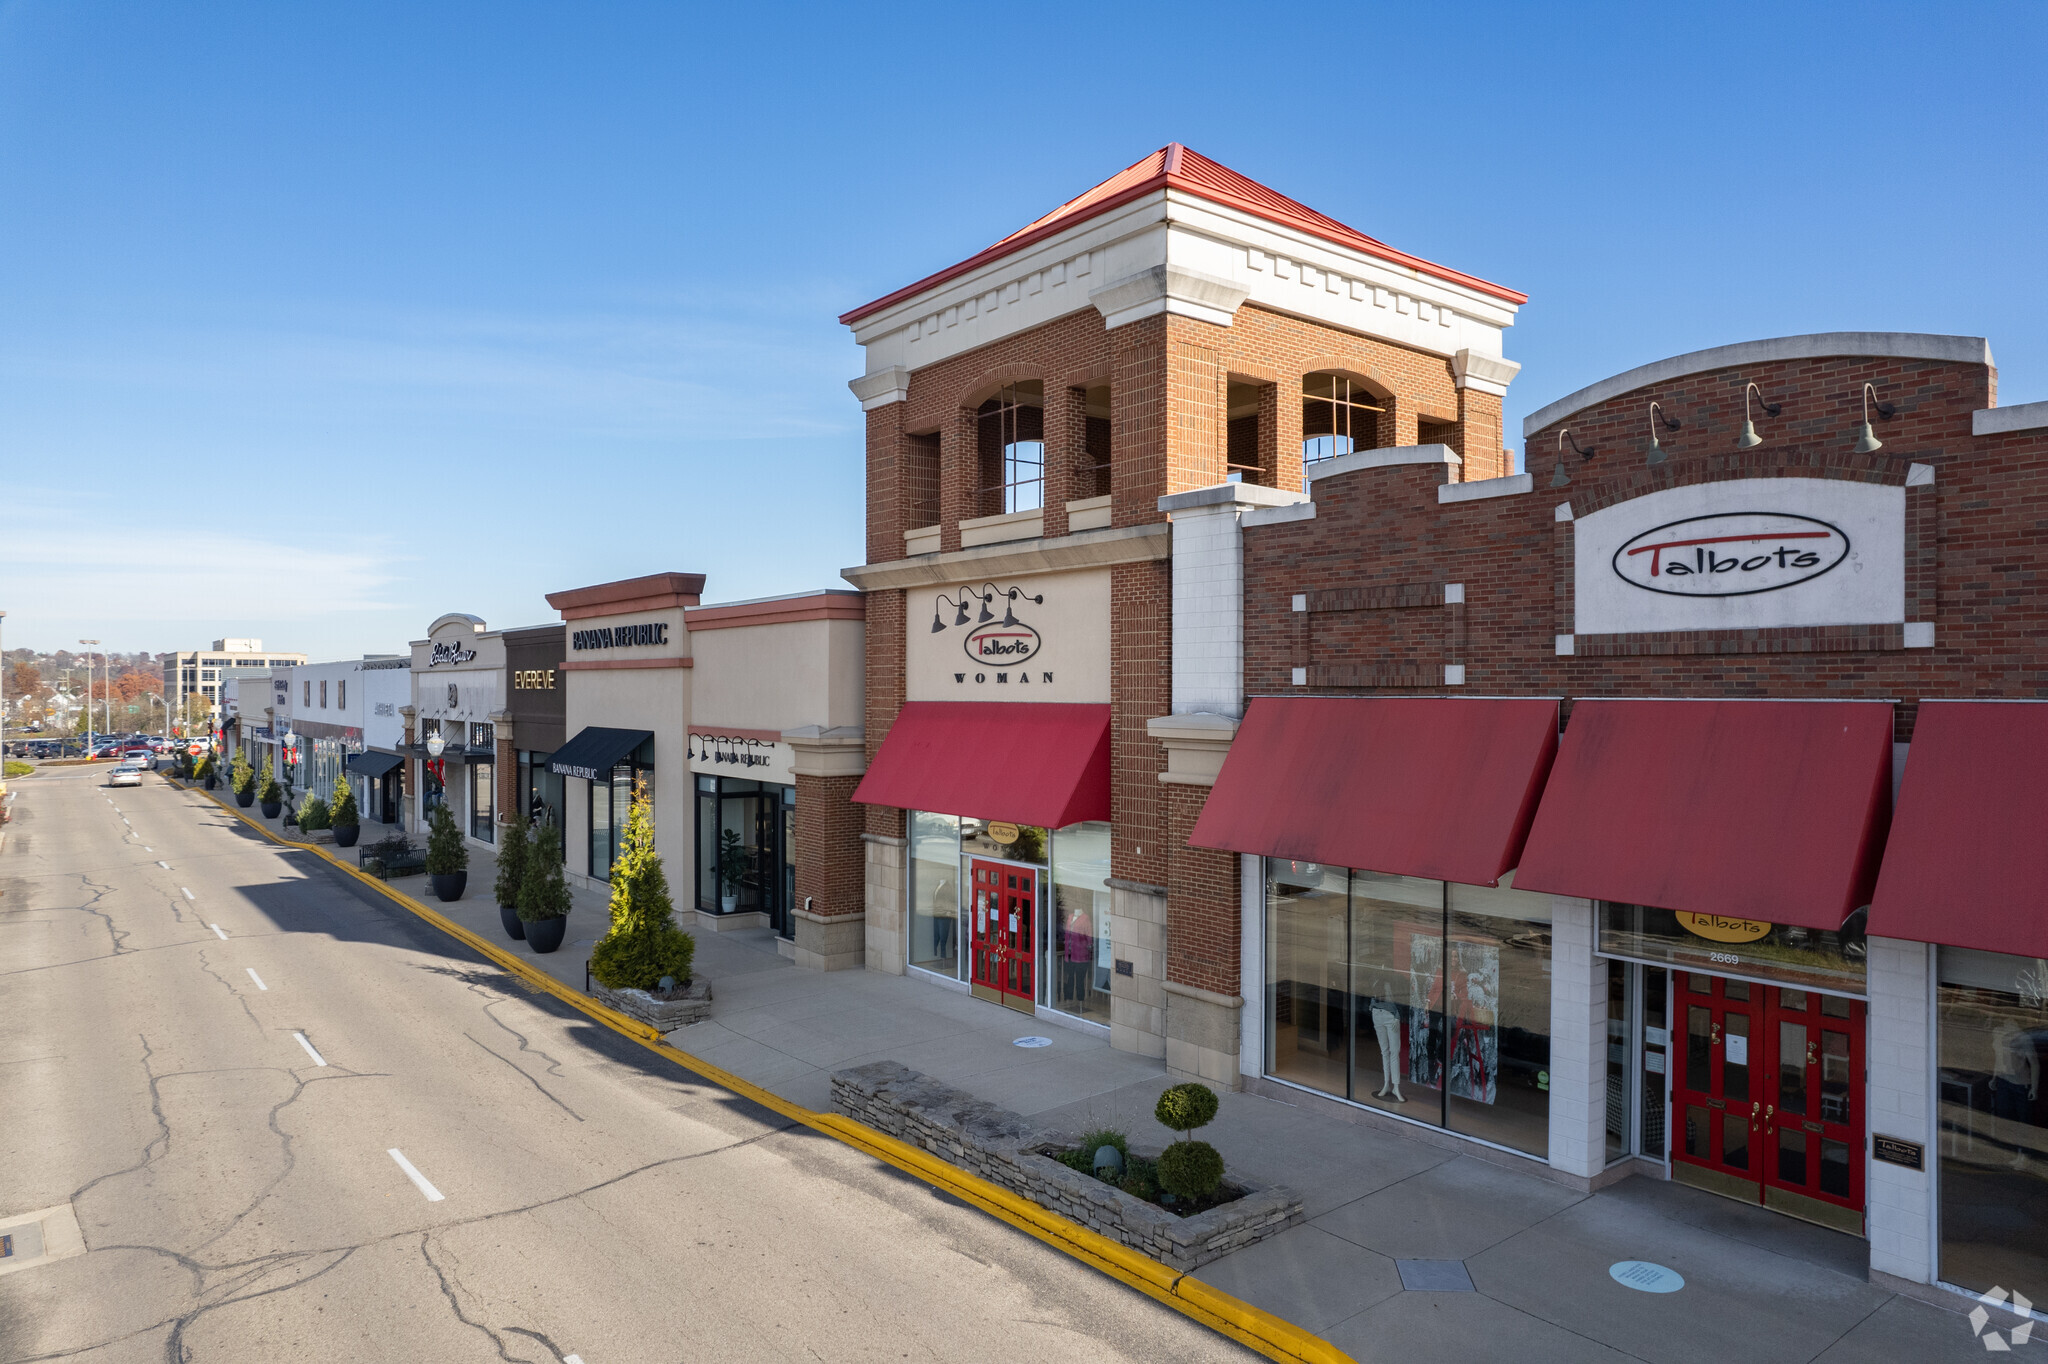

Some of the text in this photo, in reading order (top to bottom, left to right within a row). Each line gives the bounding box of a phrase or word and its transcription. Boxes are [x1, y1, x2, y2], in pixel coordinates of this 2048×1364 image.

[1627, 531, 1831, 577] Talbots
[573, 623, 668, 650] BANANA REPUBLIC
[971, 632, 1033, 655] Talbots
[429, 642, 450, 667] Eddie
[514, 669, 556, 690] EVEREVE
[954, 672, 1053, 684] WOMAN
[552, 762, 598, 780] BANANA REPUBLIC
[989, 825, 1016, 838] Talbots
[1692, 912, 1761, 933] Talbots
[1710, 952, 1739, 964] 2669
[1877, 1139, 1919, 1156] Talbots
